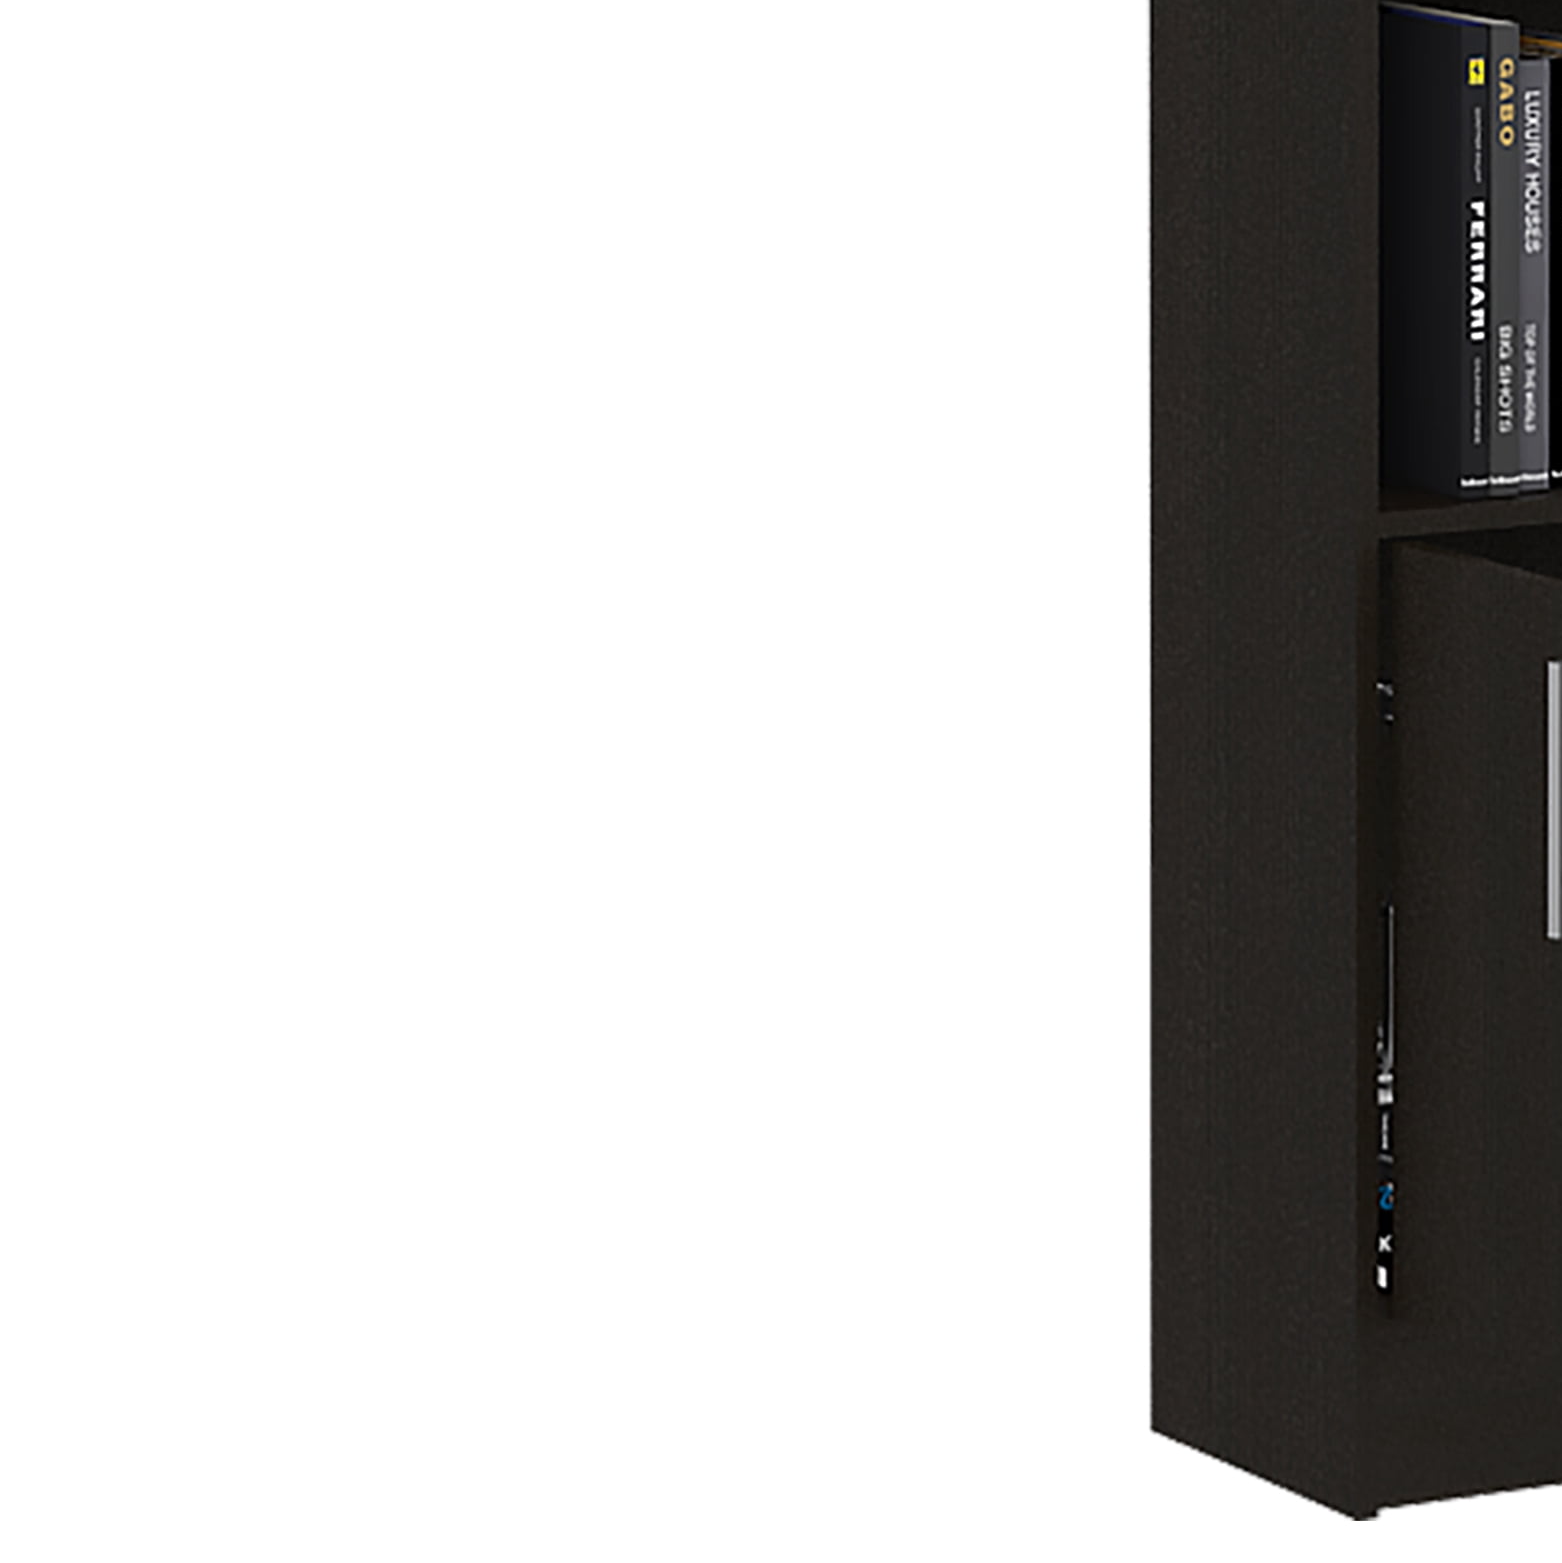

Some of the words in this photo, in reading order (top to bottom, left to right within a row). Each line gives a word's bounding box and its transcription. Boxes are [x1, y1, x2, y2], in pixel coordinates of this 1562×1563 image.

[1499, 57, 1515, 147] GABO
[1524, 90, 1542, 167] LUXURY
[1524, 170, 1542, 254] HOUSES
[1470, 201, 1486, 341] FERRARI
[1499, 324, 1513, 361] BIG
[1499, 362, 1513, 433] SHOTS
